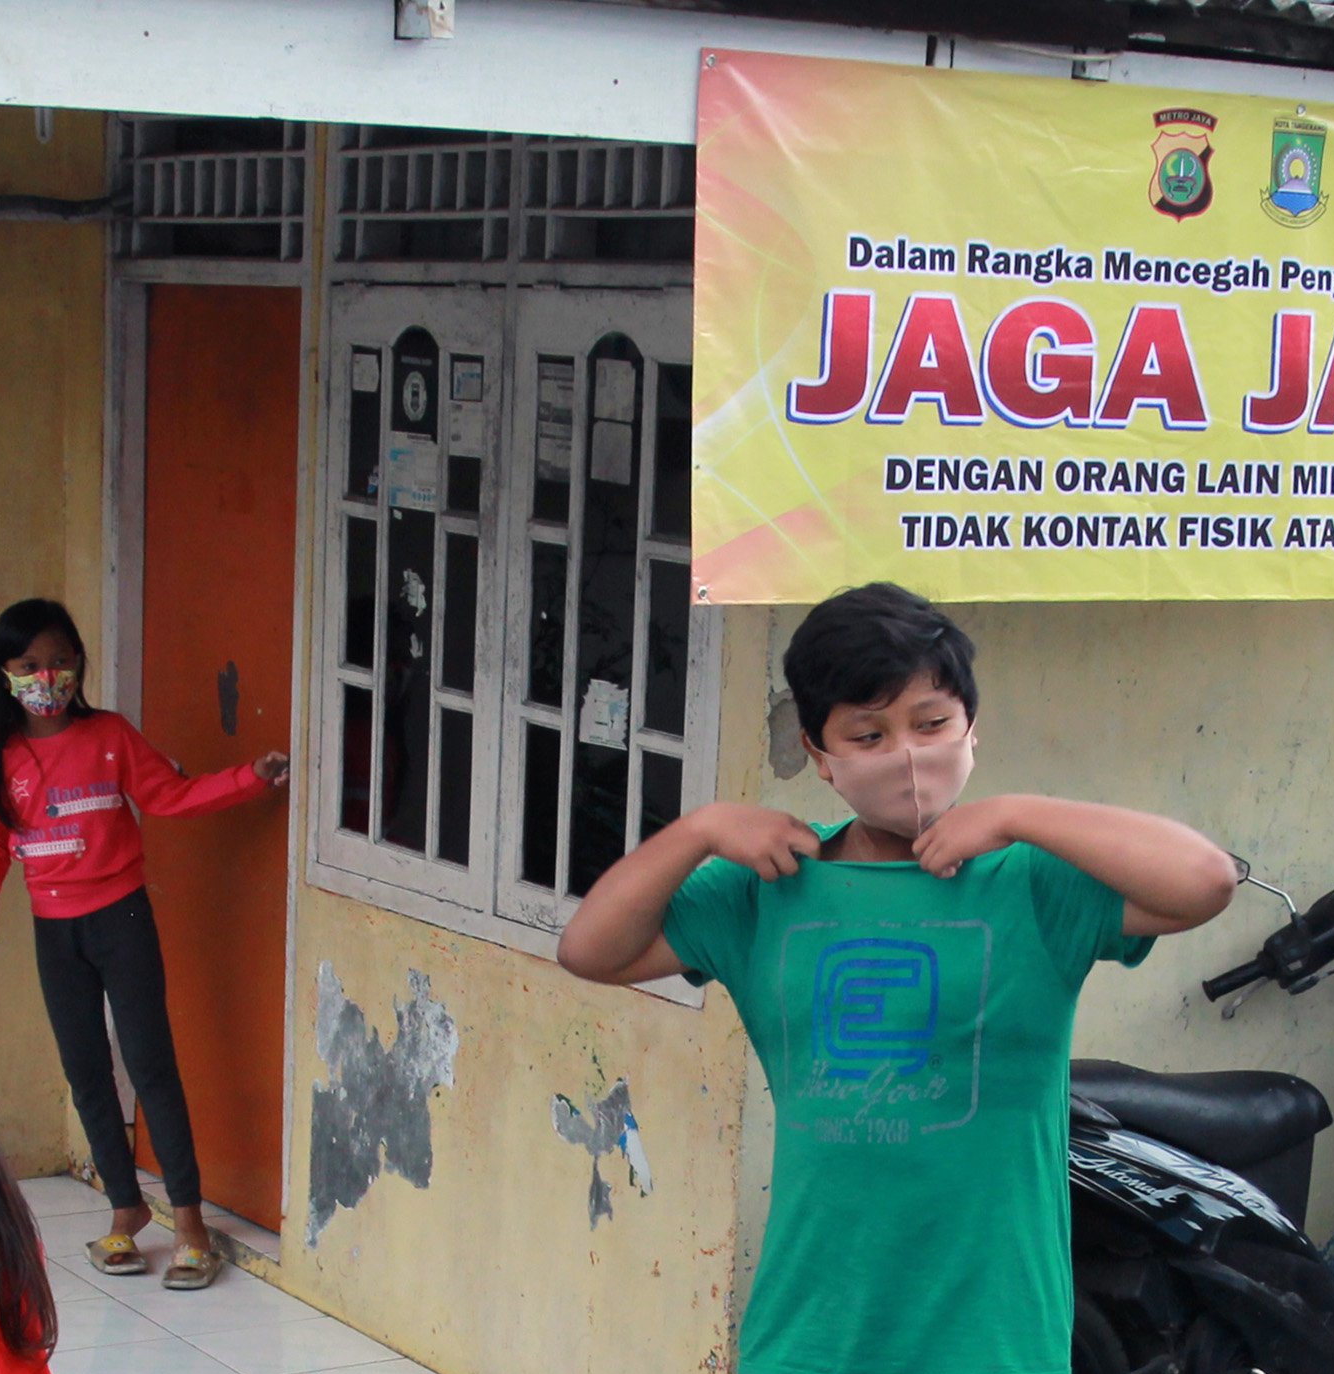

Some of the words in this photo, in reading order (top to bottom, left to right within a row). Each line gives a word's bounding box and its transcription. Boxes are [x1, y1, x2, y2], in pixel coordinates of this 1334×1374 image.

[1159, 112, 1189, 122] METRO
[1191, 113, 1212, 126] JAYA
[847, 235, 956, 274] Dalam
[967, 244, 1094, 283] Rangka
[1104, 249, 1271, 294] Mencegah
[786, 289, 1211, 431] JAGA
[885, 457, 1046, 495] DENGAN
[1056, 459, 1187, 495] ORANG
[1198, 461, 1282, 497] LAIN
[902, 515, 1010, 548] TIDAK
[1021, 515, 1169, 549] KONTAK
[1180, 517, 1273, 549] FISIK
